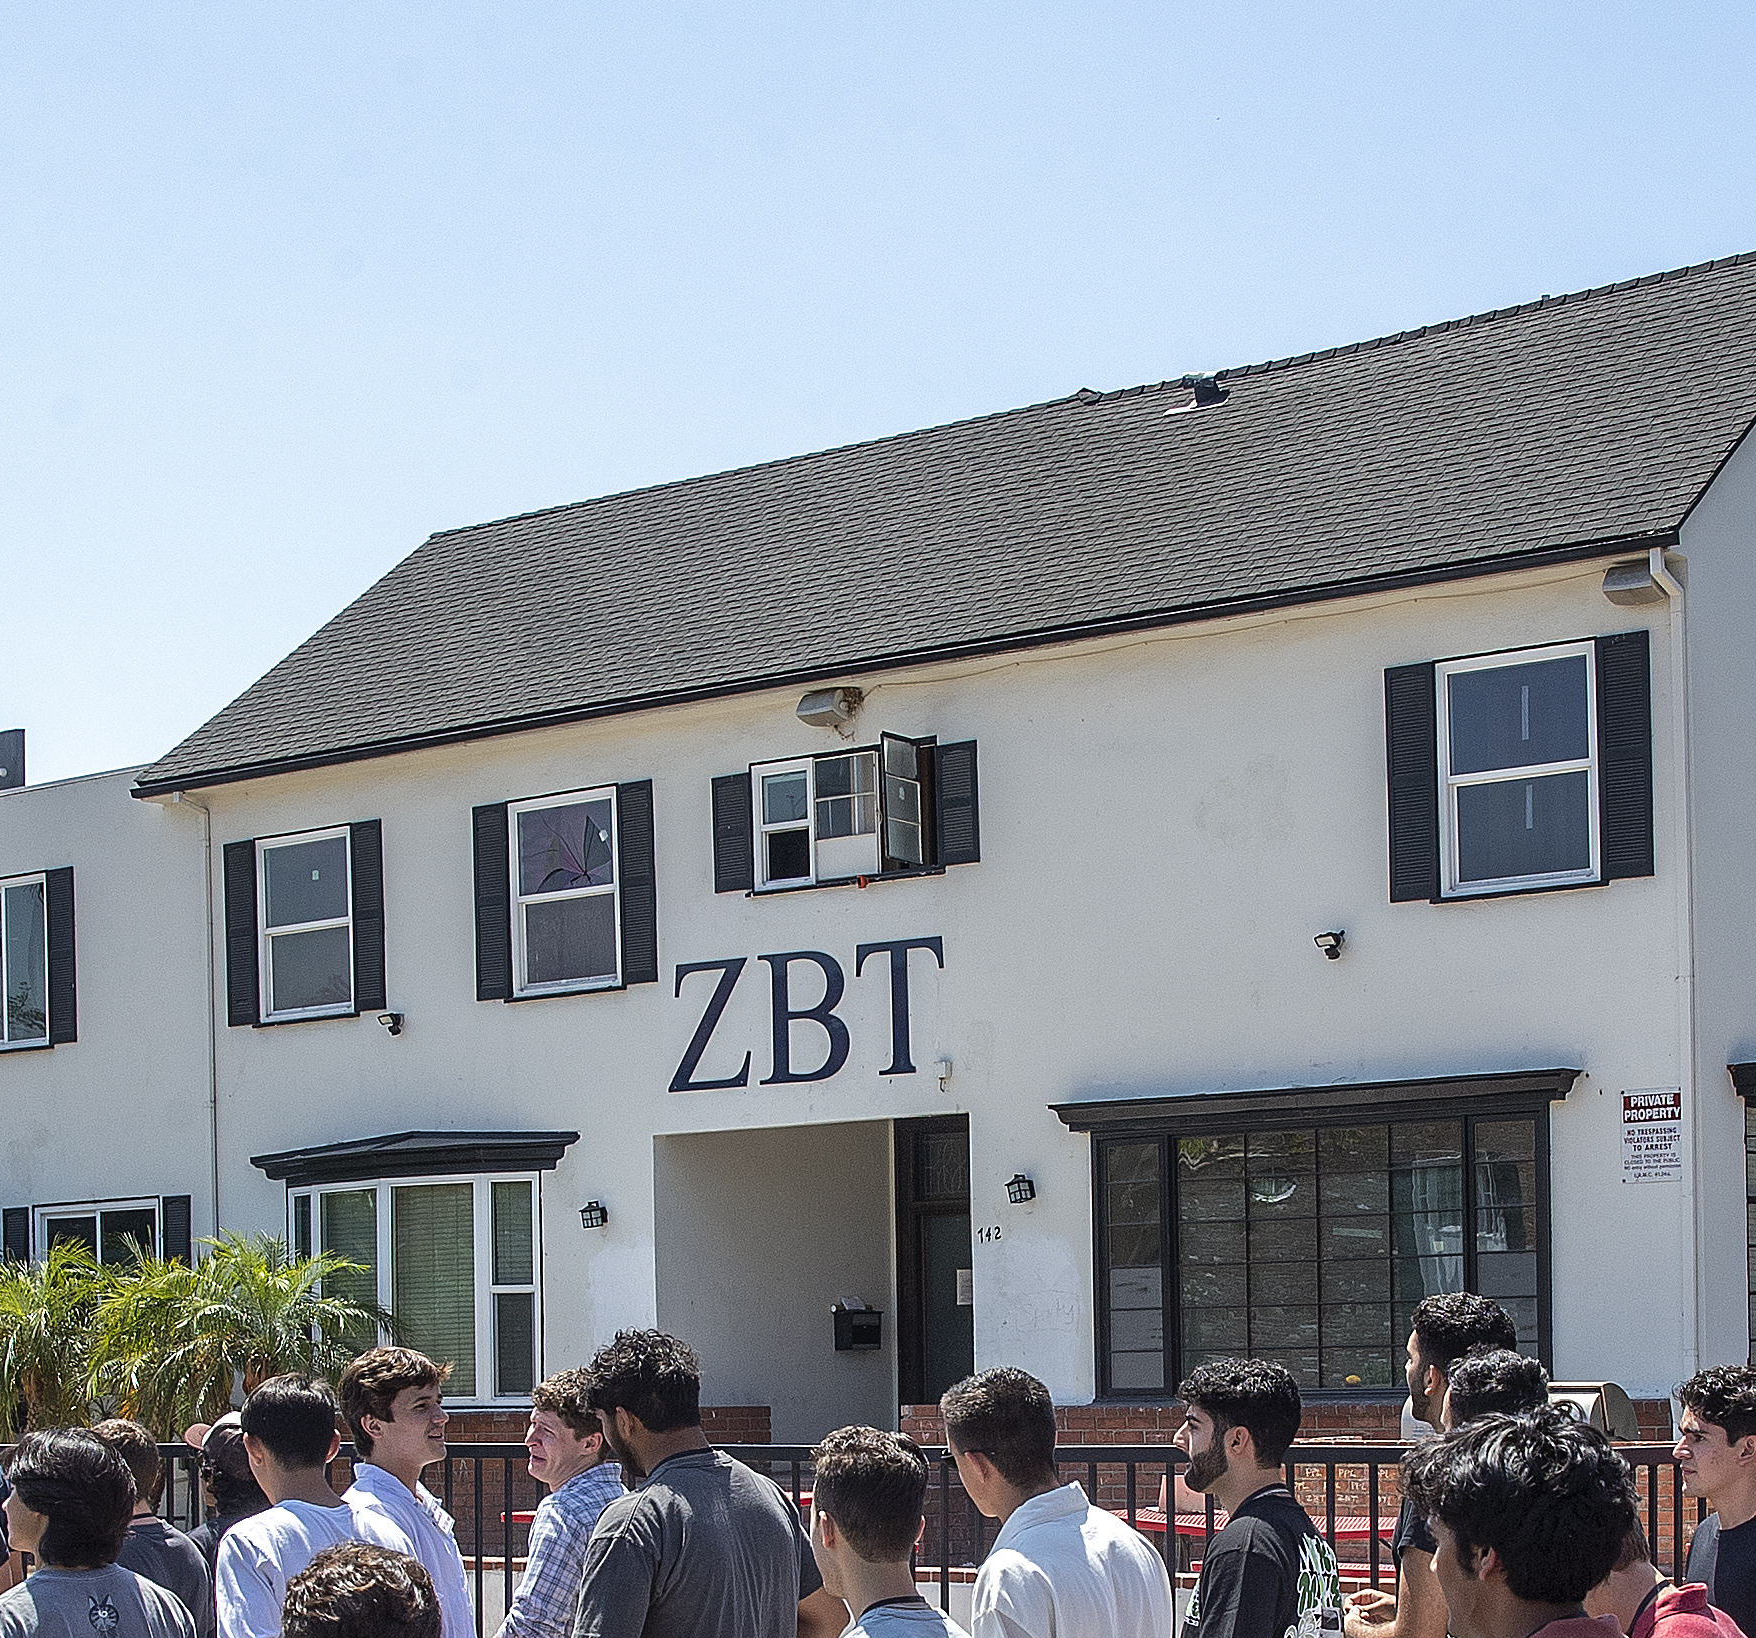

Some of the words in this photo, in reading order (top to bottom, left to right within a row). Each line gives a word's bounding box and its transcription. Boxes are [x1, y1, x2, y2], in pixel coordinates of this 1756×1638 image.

[668, 935, 945, 1093] ZBT
[1630, 1094, 1674, 1108] PRIVATE
[1624, 1107, 1681, 1121] PROPERTY
[1644, 1143, 1673, 1151] ARREST
